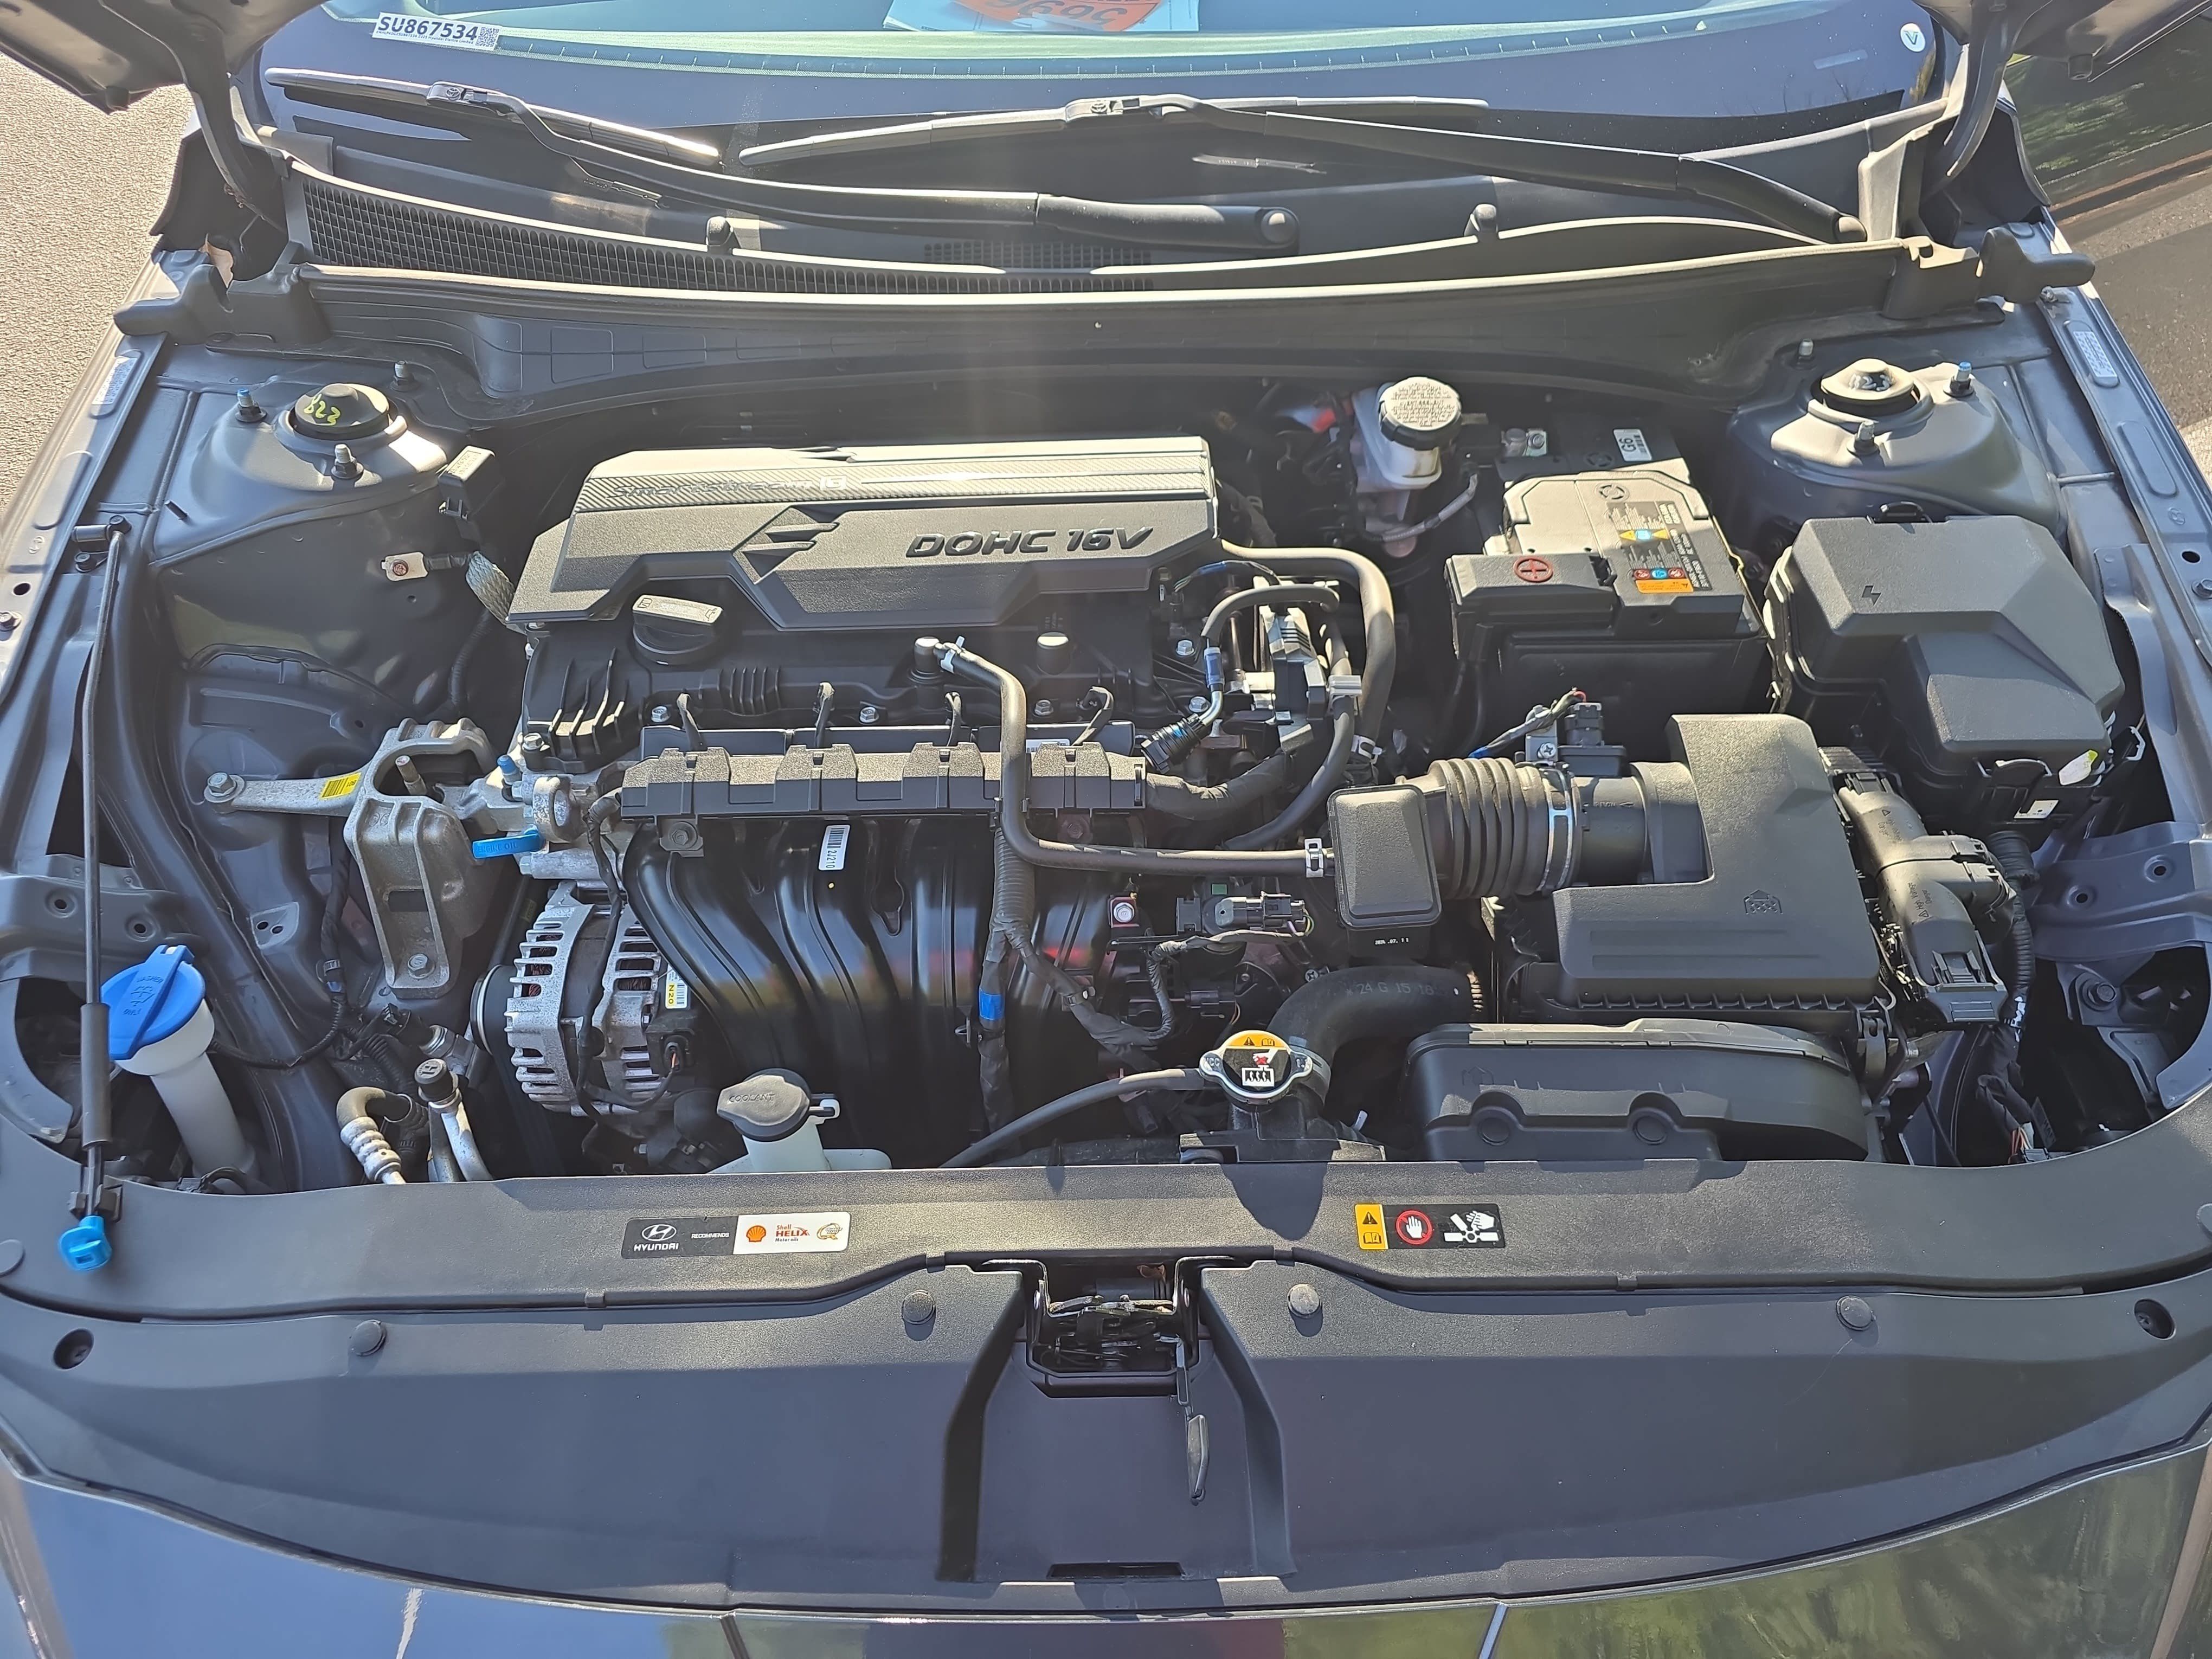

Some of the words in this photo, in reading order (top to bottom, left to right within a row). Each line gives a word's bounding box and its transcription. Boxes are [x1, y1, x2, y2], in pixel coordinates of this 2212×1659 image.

[378, 16, 479, 41] SU867534
[1619, 436, 1637, 453] G6
[905, 529, 1057, 558] DOHC
[1066, 526, 1154, 552] 16V
[477, 843, 502, 853] ENGINE
[504, 841, 518, 850] OIL
[728, 1093, 776, 1103] COOLANT
[776, 1229, 809, 1237] HELIX
[634, 1243, 679, 1251] HYUNDAI
